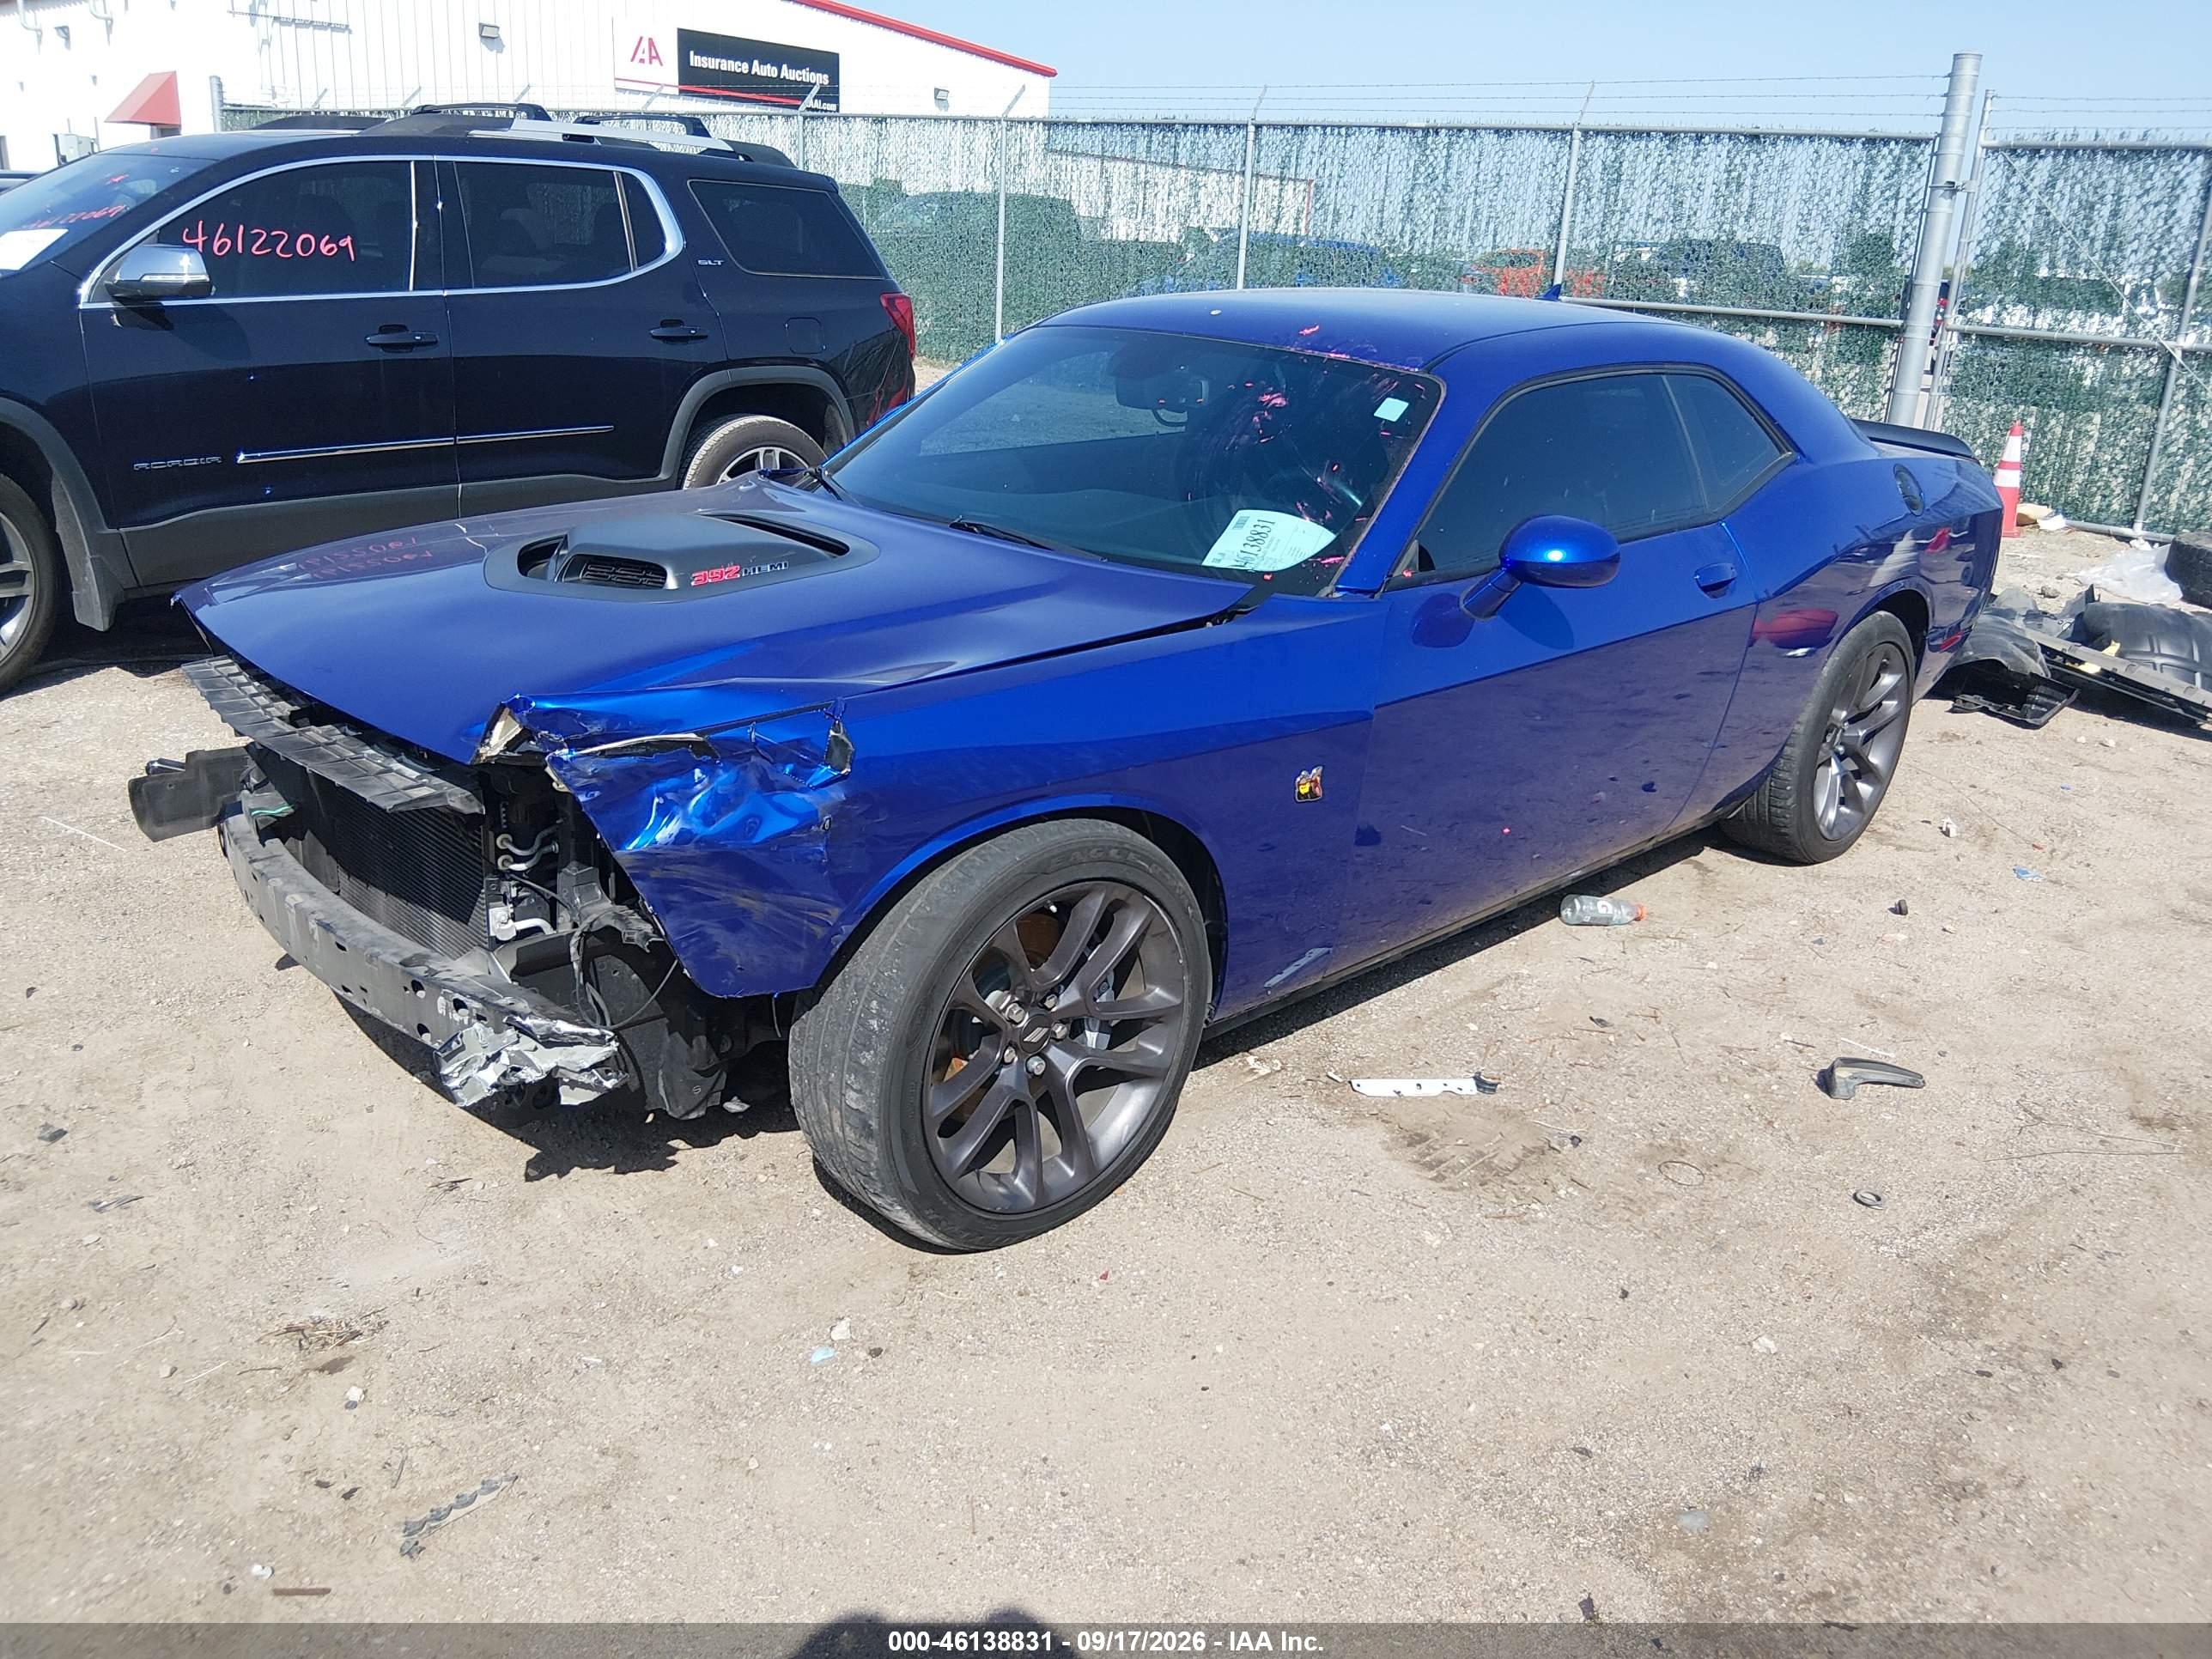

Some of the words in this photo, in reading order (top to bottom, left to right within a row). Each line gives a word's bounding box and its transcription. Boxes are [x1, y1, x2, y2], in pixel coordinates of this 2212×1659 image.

[690, 50, 749, 74] Insurance
[750, 58, 778, 78] Auto
[780, 64, 830, 85] Auctions
[807, 98, 837, 112] AAI.com
[181, 220, 356, 262] 46122069
[133, 456, 222, 471] ACADIA
[691, 565, 740, 586] 392
[742, 561, 788, 577] HEMI
